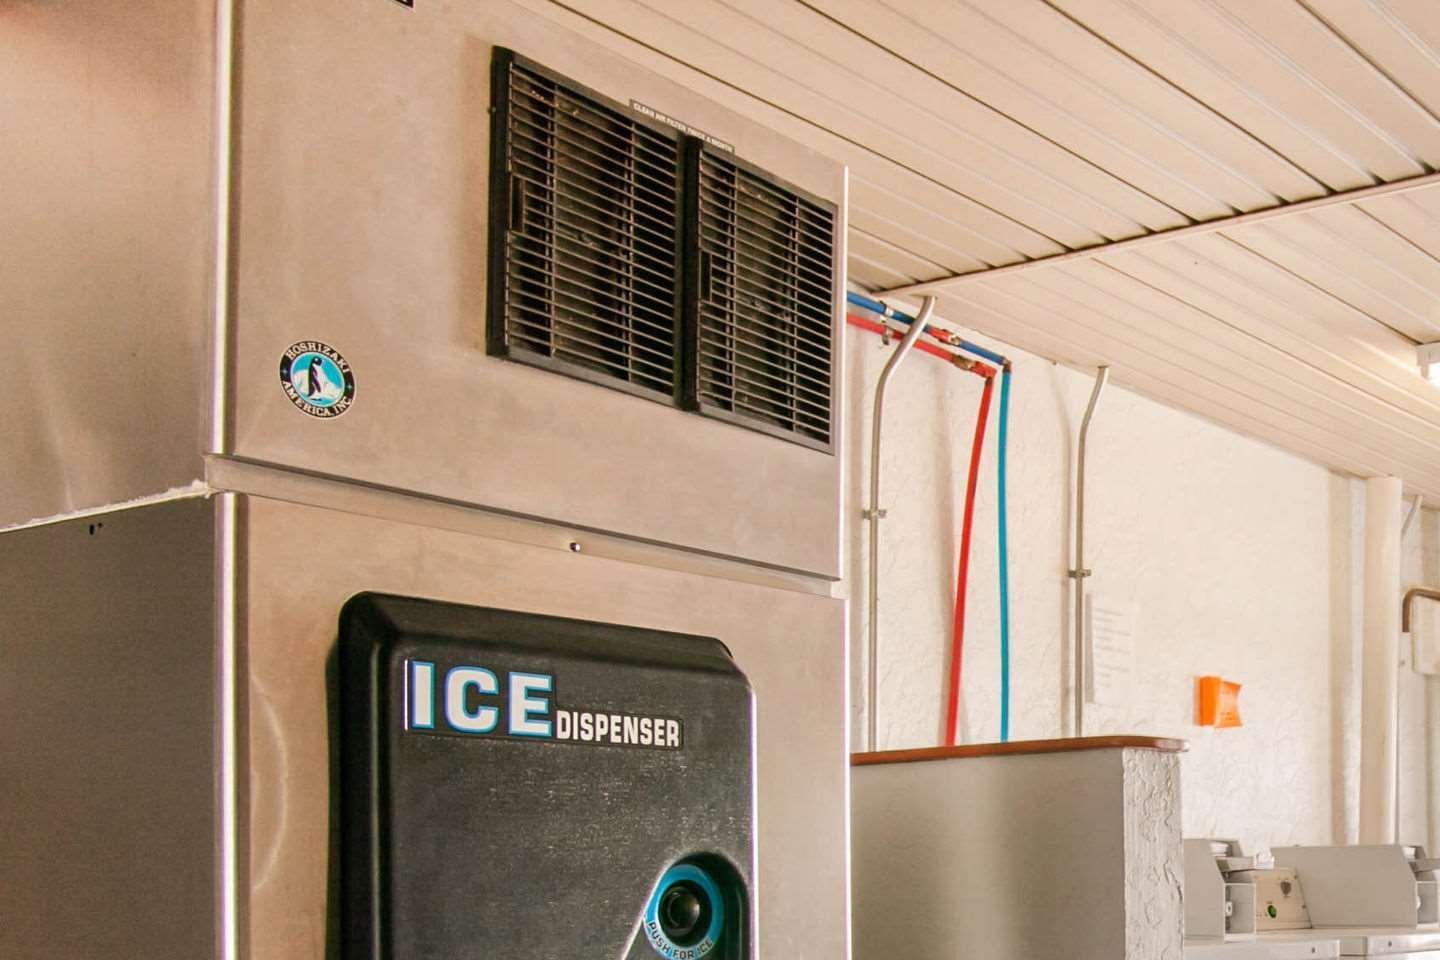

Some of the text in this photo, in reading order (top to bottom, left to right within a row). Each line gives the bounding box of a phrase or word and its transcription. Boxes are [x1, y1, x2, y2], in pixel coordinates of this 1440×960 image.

[285, 342, 351, 373] HOSHIZAKI
[411, 660, 680, 747] ICE DISPENSER
[647, 920, 715, 960] PUSH FOR ICE
